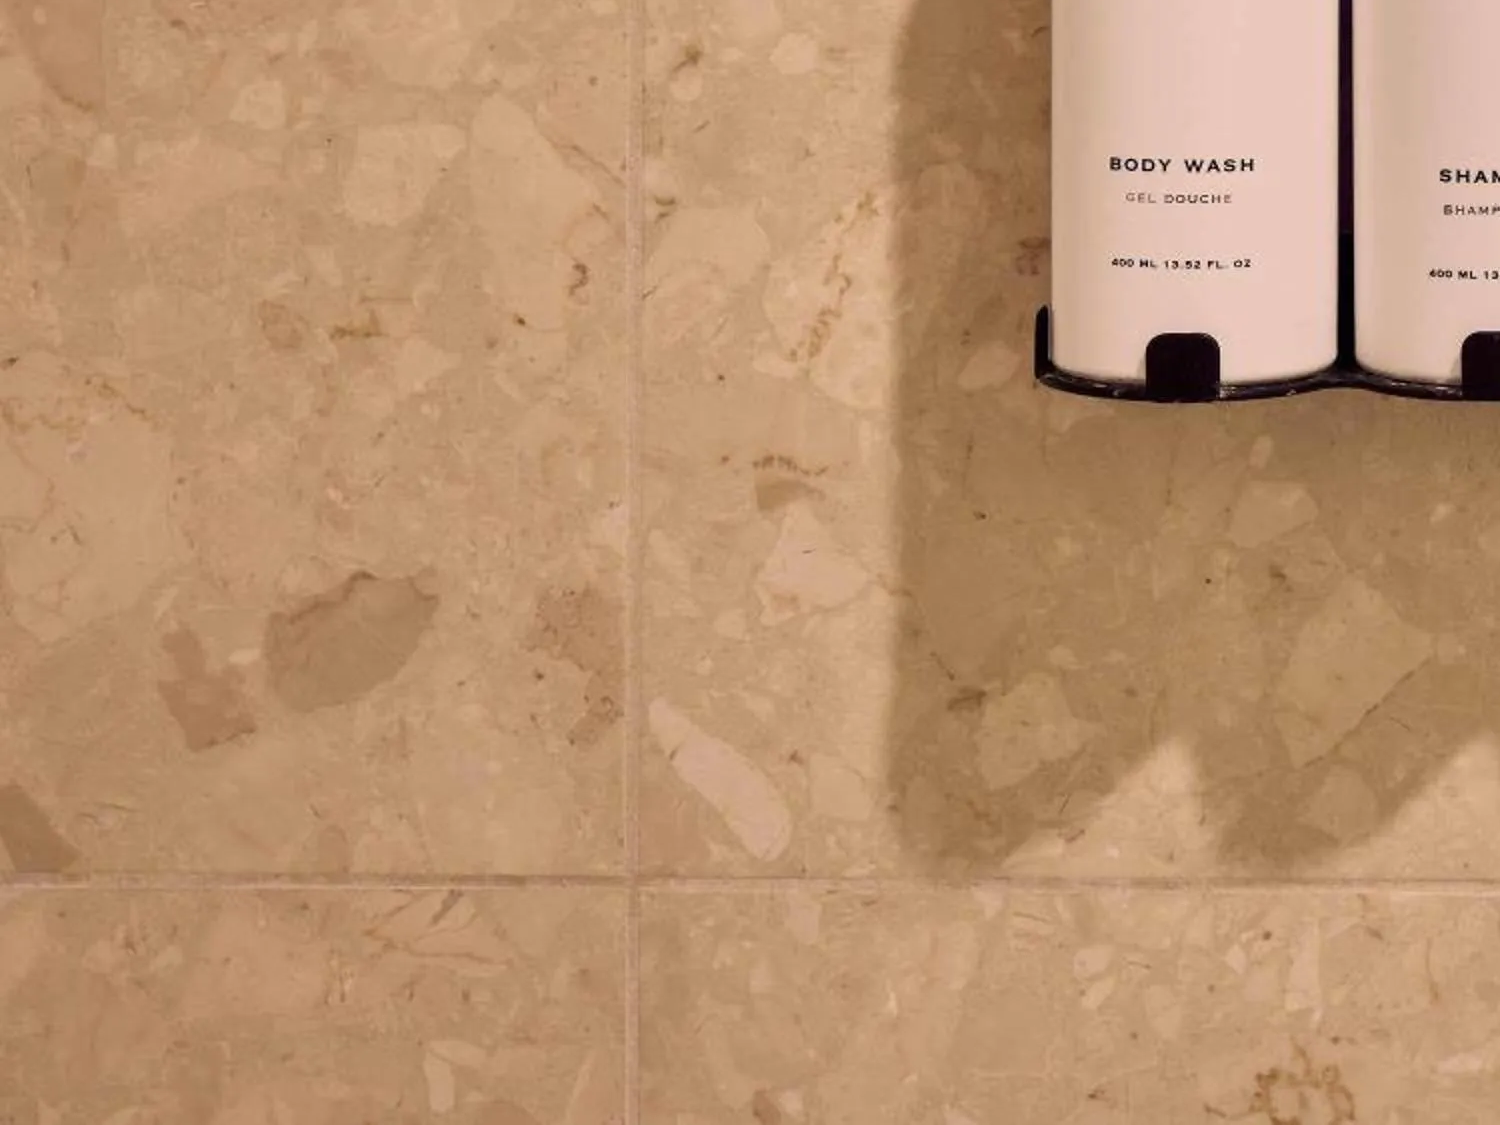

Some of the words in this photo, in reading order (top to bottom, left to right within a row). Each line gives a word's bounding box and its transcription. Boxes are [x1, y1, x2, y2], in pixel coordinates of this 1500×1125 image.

[1109, 156, 1172, 173] BODY
[1183, 157, 1256, 174] WASH
[1124, 192, 1157, 205] GEL
[1163, 192, 1234, 205] DOUCHE
[1111, 257, 1135, 269] 400
[1139, 258, 1158, 269] ML
[1164, 259, 1202, 270] 13.52
[1232, 258, 1252, 269] OZ
[1428, 268, 1454, 279] 400
[1457, 269, 1478, 280] ML
